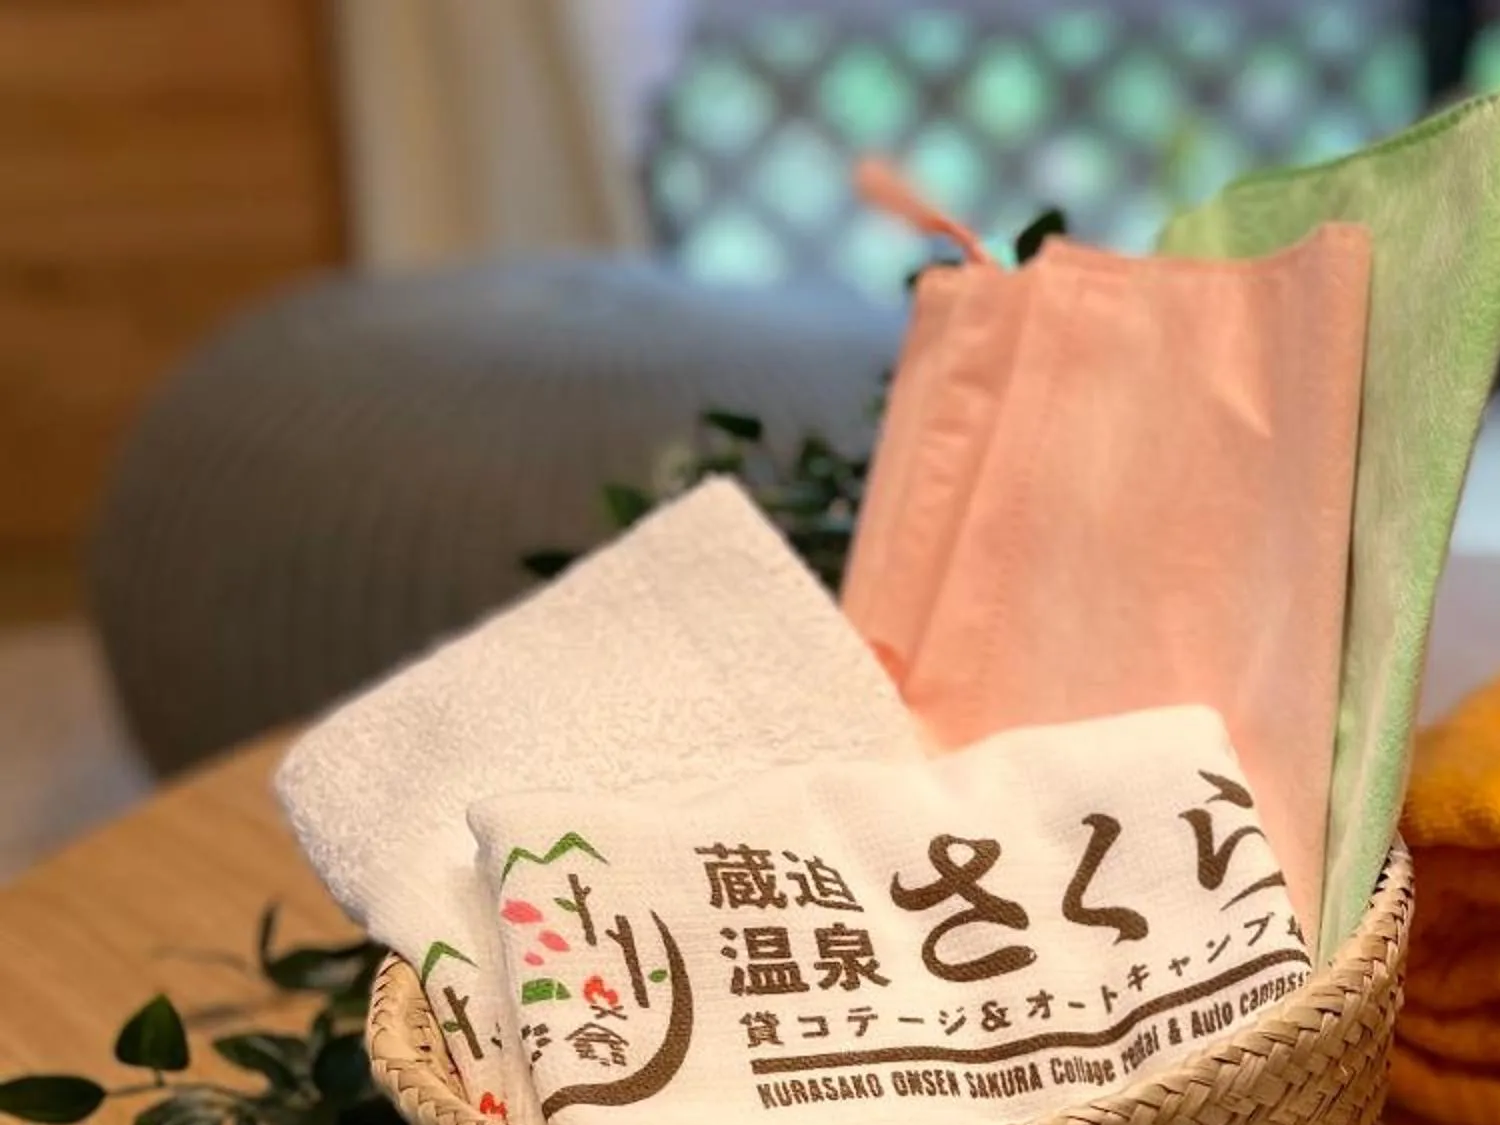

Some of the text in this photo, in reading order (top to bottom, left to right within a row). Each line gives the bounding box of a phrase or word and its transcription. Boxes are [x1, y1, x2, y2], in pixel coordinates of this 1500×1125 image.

[694, 842, 865, 912] 蔵迫
[890, 768, 1287, 983] さくら
[719, 921, 892, 996] 温泉
[756, 1072, 886, 1110] KURASAKO
[890, 1068, 961, 1099] ONSEN
[963, 1061, 1044, 1100] SAKURA
[1167, 1017, 1183, 1046] &
[1190, 1001, 1234, 1039] Auto
